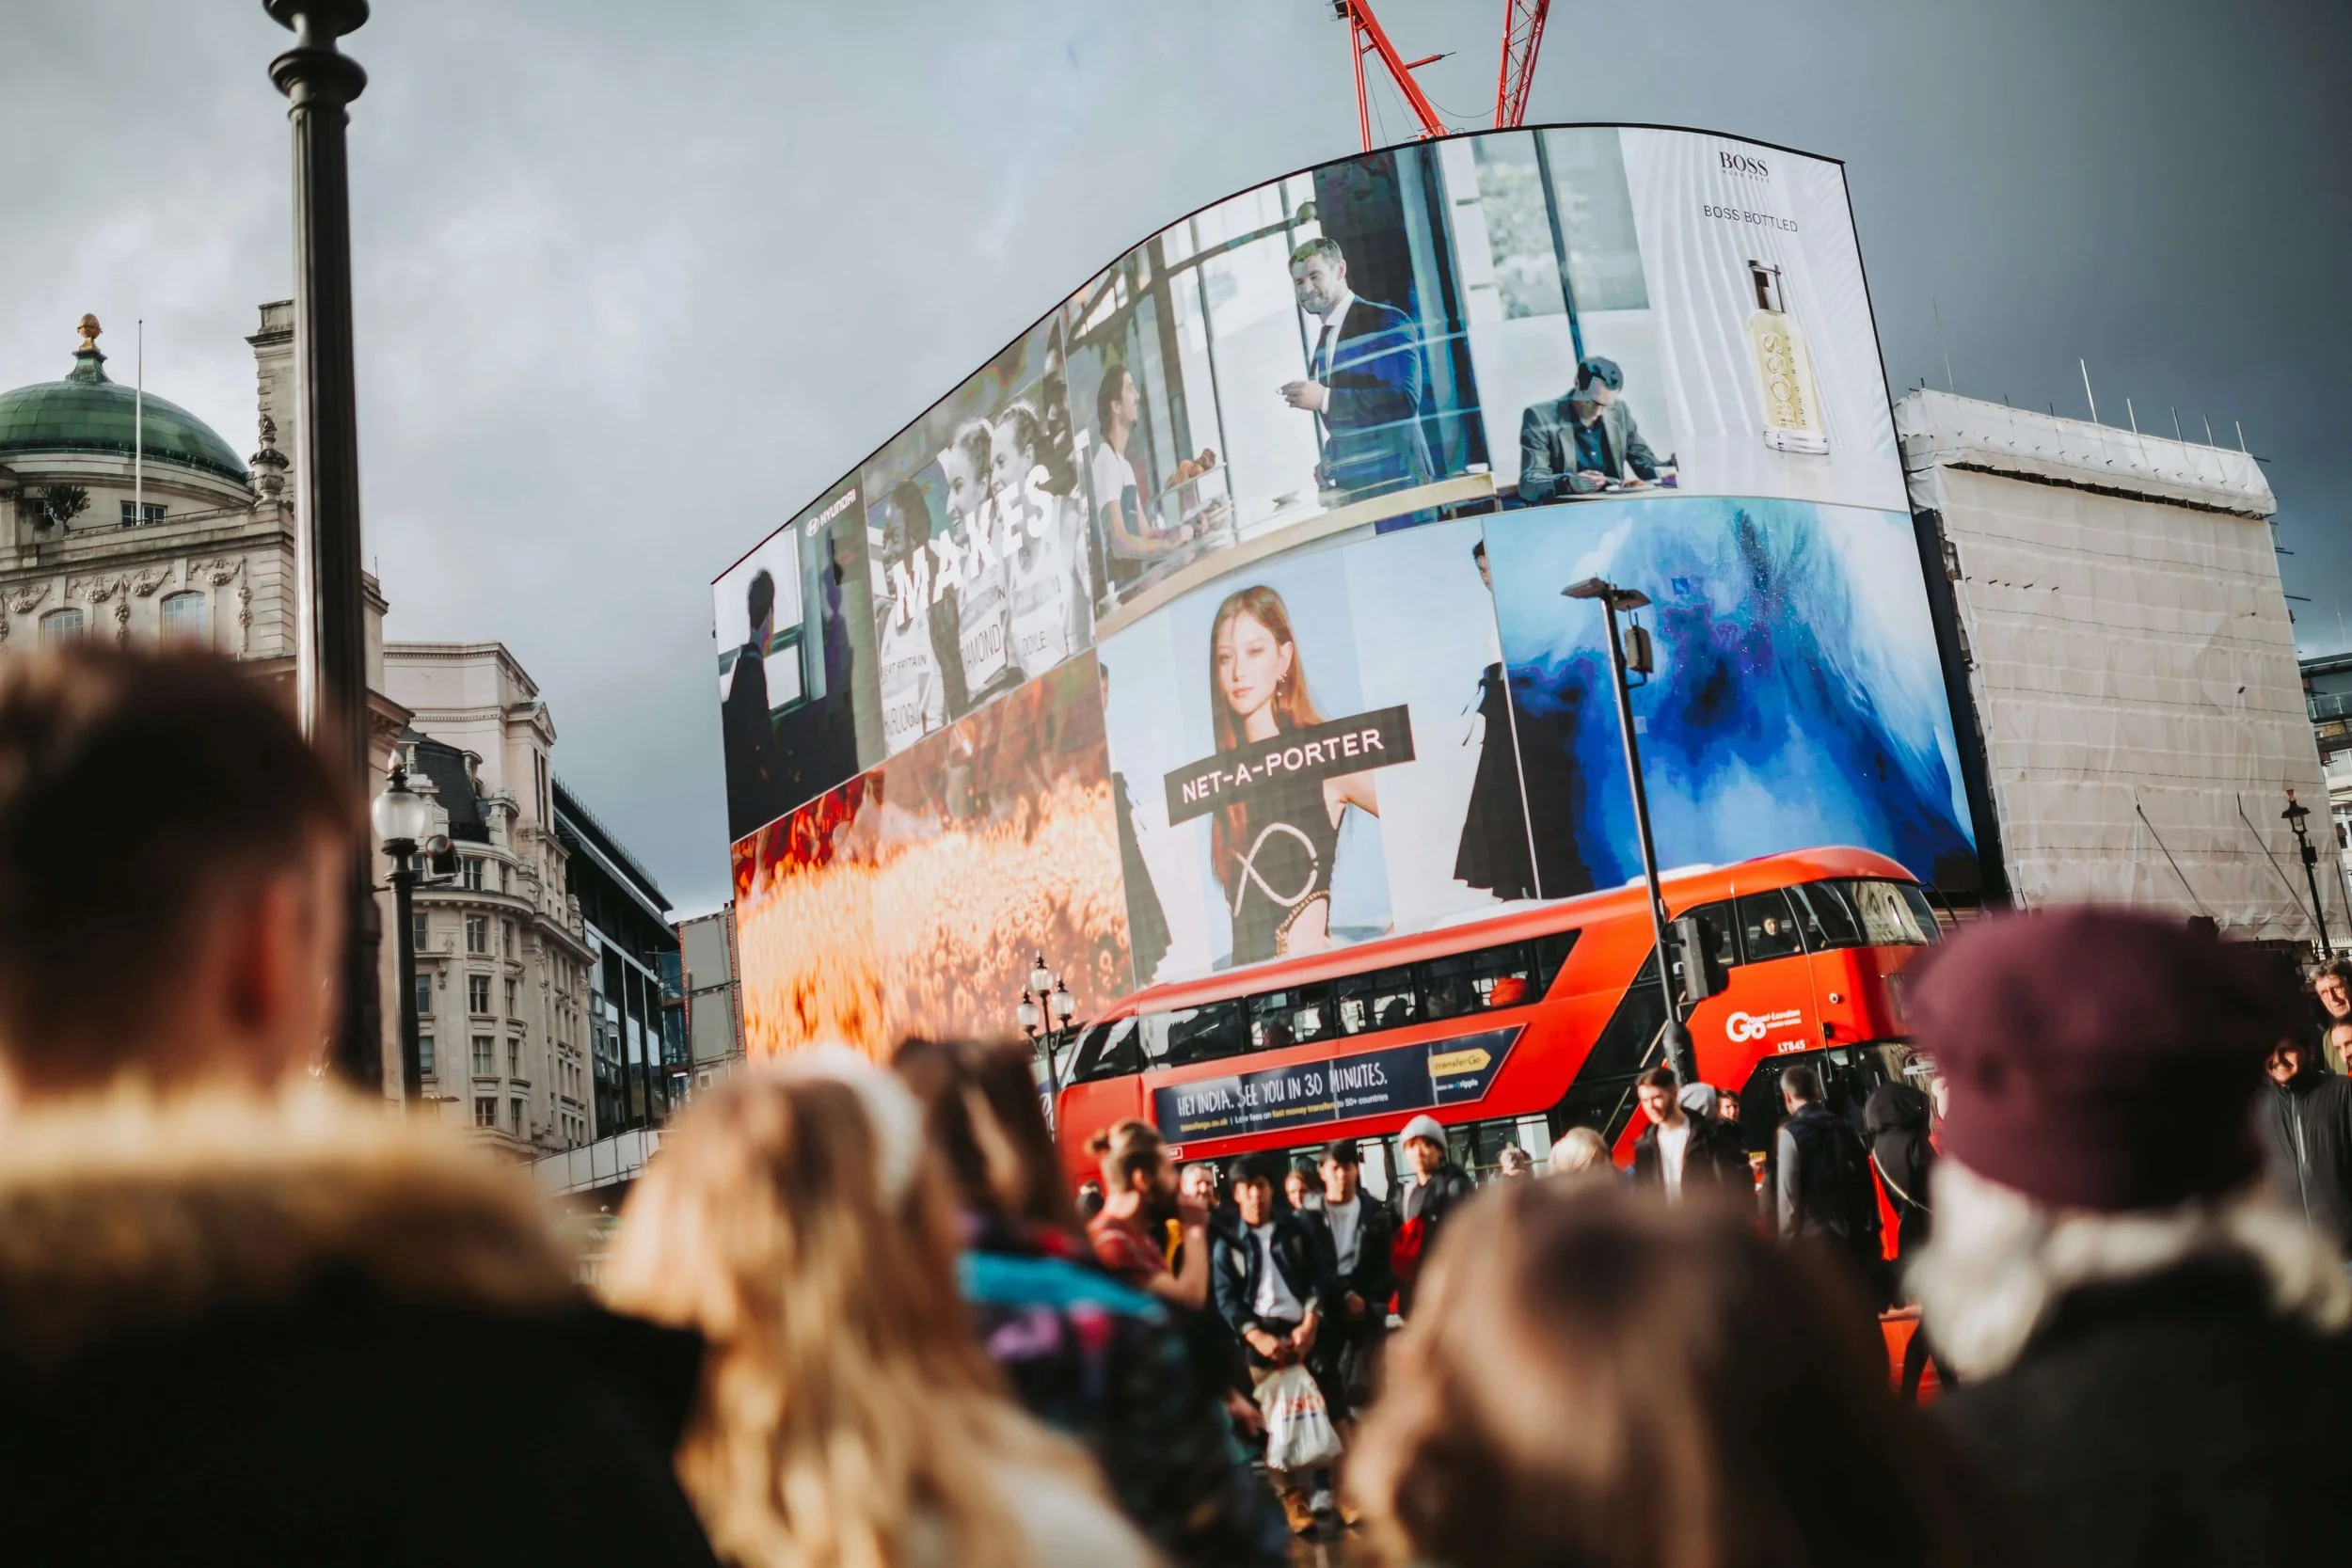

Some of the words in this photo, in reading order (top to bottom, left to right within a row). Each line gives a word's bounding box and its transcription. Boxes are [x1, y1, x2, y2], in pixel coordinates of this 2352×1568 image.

[1719, 151, 1769, 176] BOSS
[1704, 205, 1740, 221] BOSS
[1744, 211, 1798, 232] BOTTLED
[1763, 332, 1797, 428] BOSS
[819, 488, 857, 527] HYUNDAI
[892, 464, 1054, 628] MAKES
[1182, 728, 1385, 804] NET-A-PORTER
[1725, 1011, 1767, 1042] Go
[1777, 1039, 1805, 1053] LT845
[1177, 1095, 1195, 1117] HEY
[1197, 1088, 1234, 1115] INDIA.
[1236, 1083, 1259, 1109] SEE
[1262, 1079, 1285, 1104] YOU
[1287, 1076, 1301, 1101] IN
[1304, 1072, 1323, 1097] 30
[1328, 1062, 1388, 1094] MINUTES.
[1234, 1114, 1248, 1125] Low
[1359, 1093, 1389, 1105] countries
